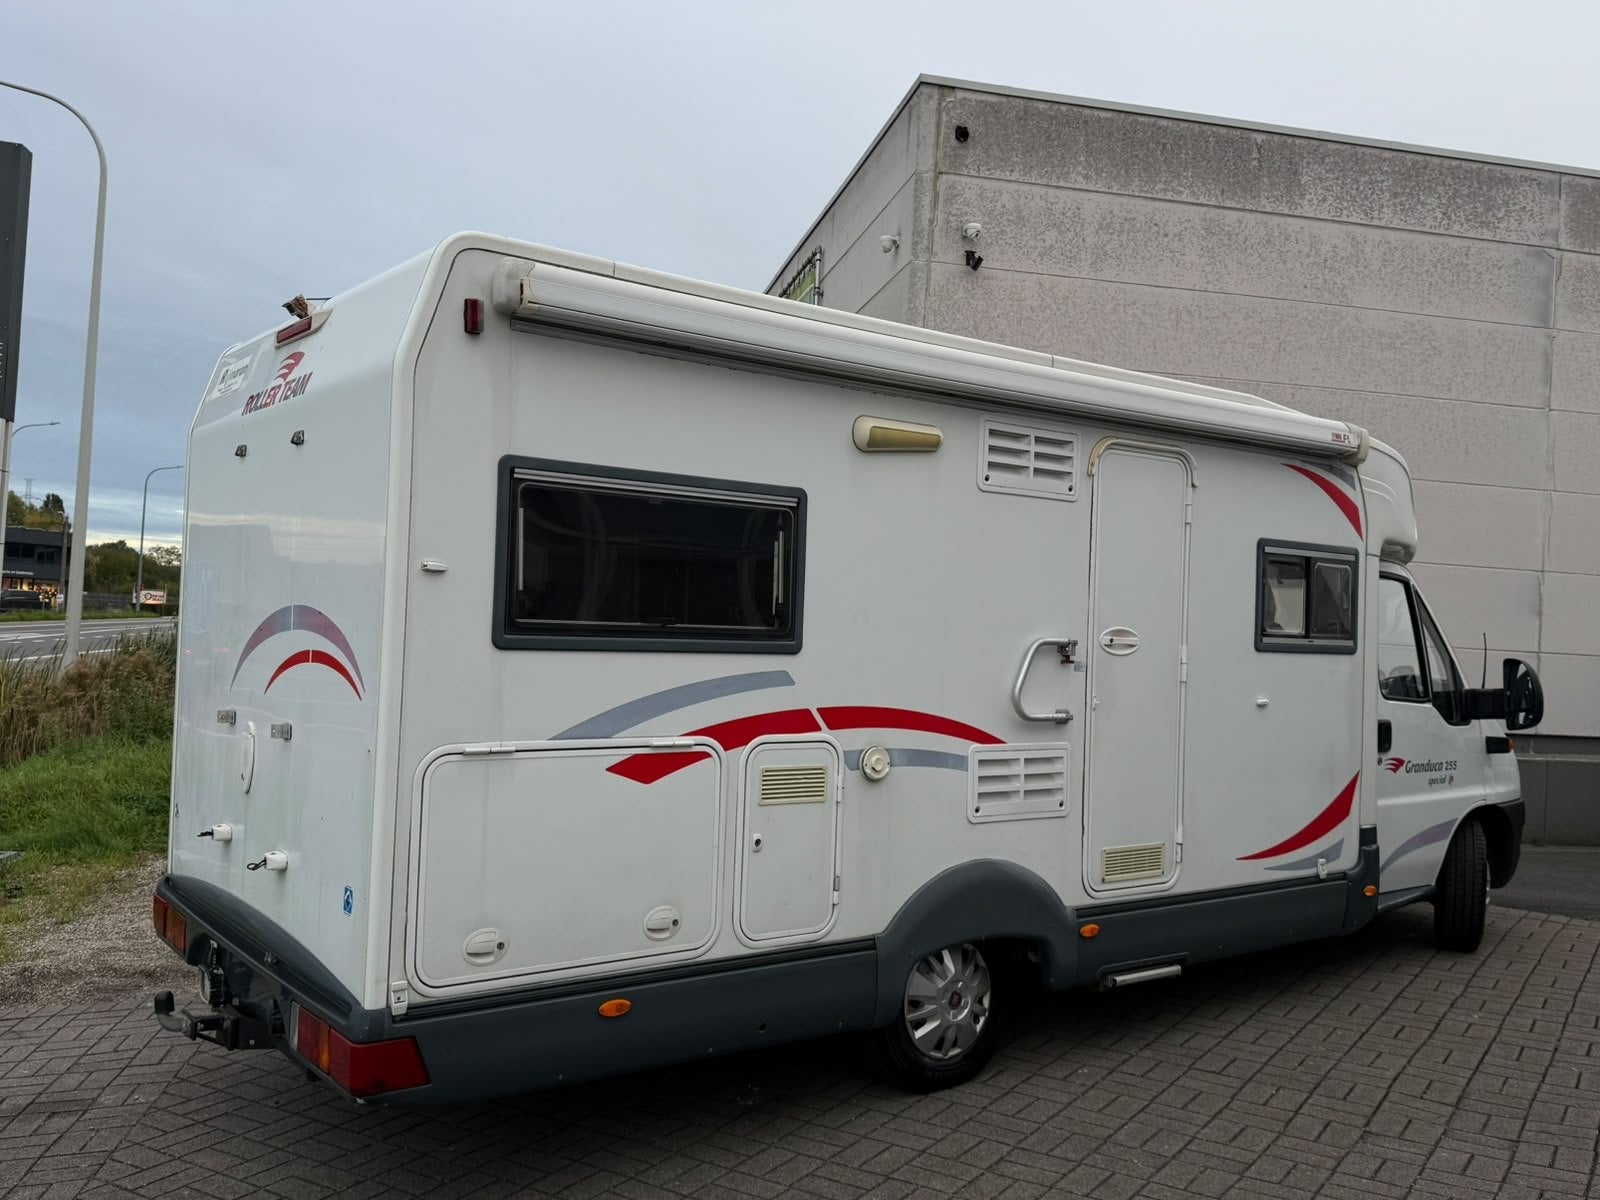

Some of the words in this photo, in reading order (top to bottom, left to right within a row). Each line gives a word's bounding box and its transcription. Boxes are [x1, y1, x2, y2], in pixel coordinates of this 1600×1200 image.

[241, 384, 282, 416] ROLLER
[279, 371, 313, 403] TEAM
[1405, 760, 1444, 774] Granduca
[1445, 760, 1458, 771] 255
